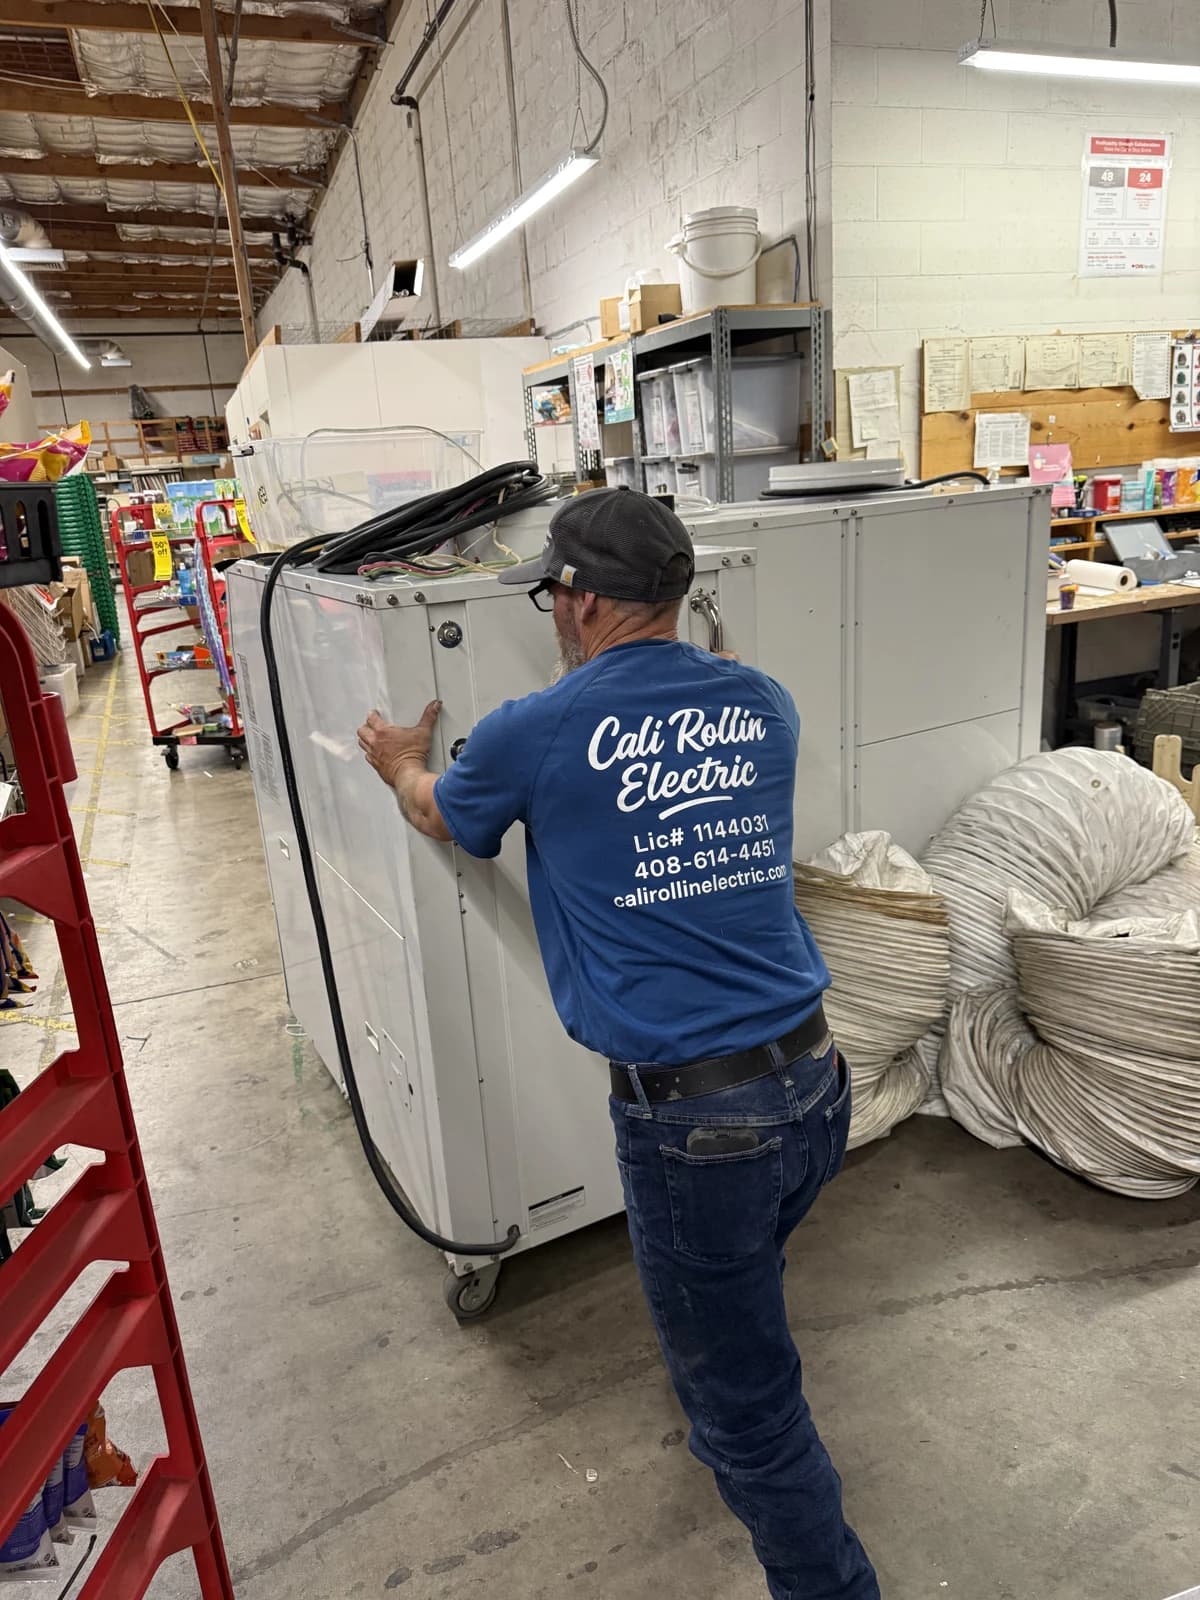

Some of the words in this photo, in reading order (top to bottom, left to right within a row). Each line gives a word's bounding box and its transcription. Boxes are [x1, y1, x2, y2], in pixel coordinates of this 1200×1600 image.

[1101, 171, 1114, 182] 48
[1139, 172, 1152, 183] 24
[588, 716, 665, 771] Cali
[668, 706, 767, 754] Rollin
[616, 755, 758, 813] Electric
[633, 827, 685, 853] Lic#
[693, 814, 769, 842] 1144031
[634, 838, 776, 879] 408-614-4451
[613, 864, 788, 908] calirollinelectric.com
